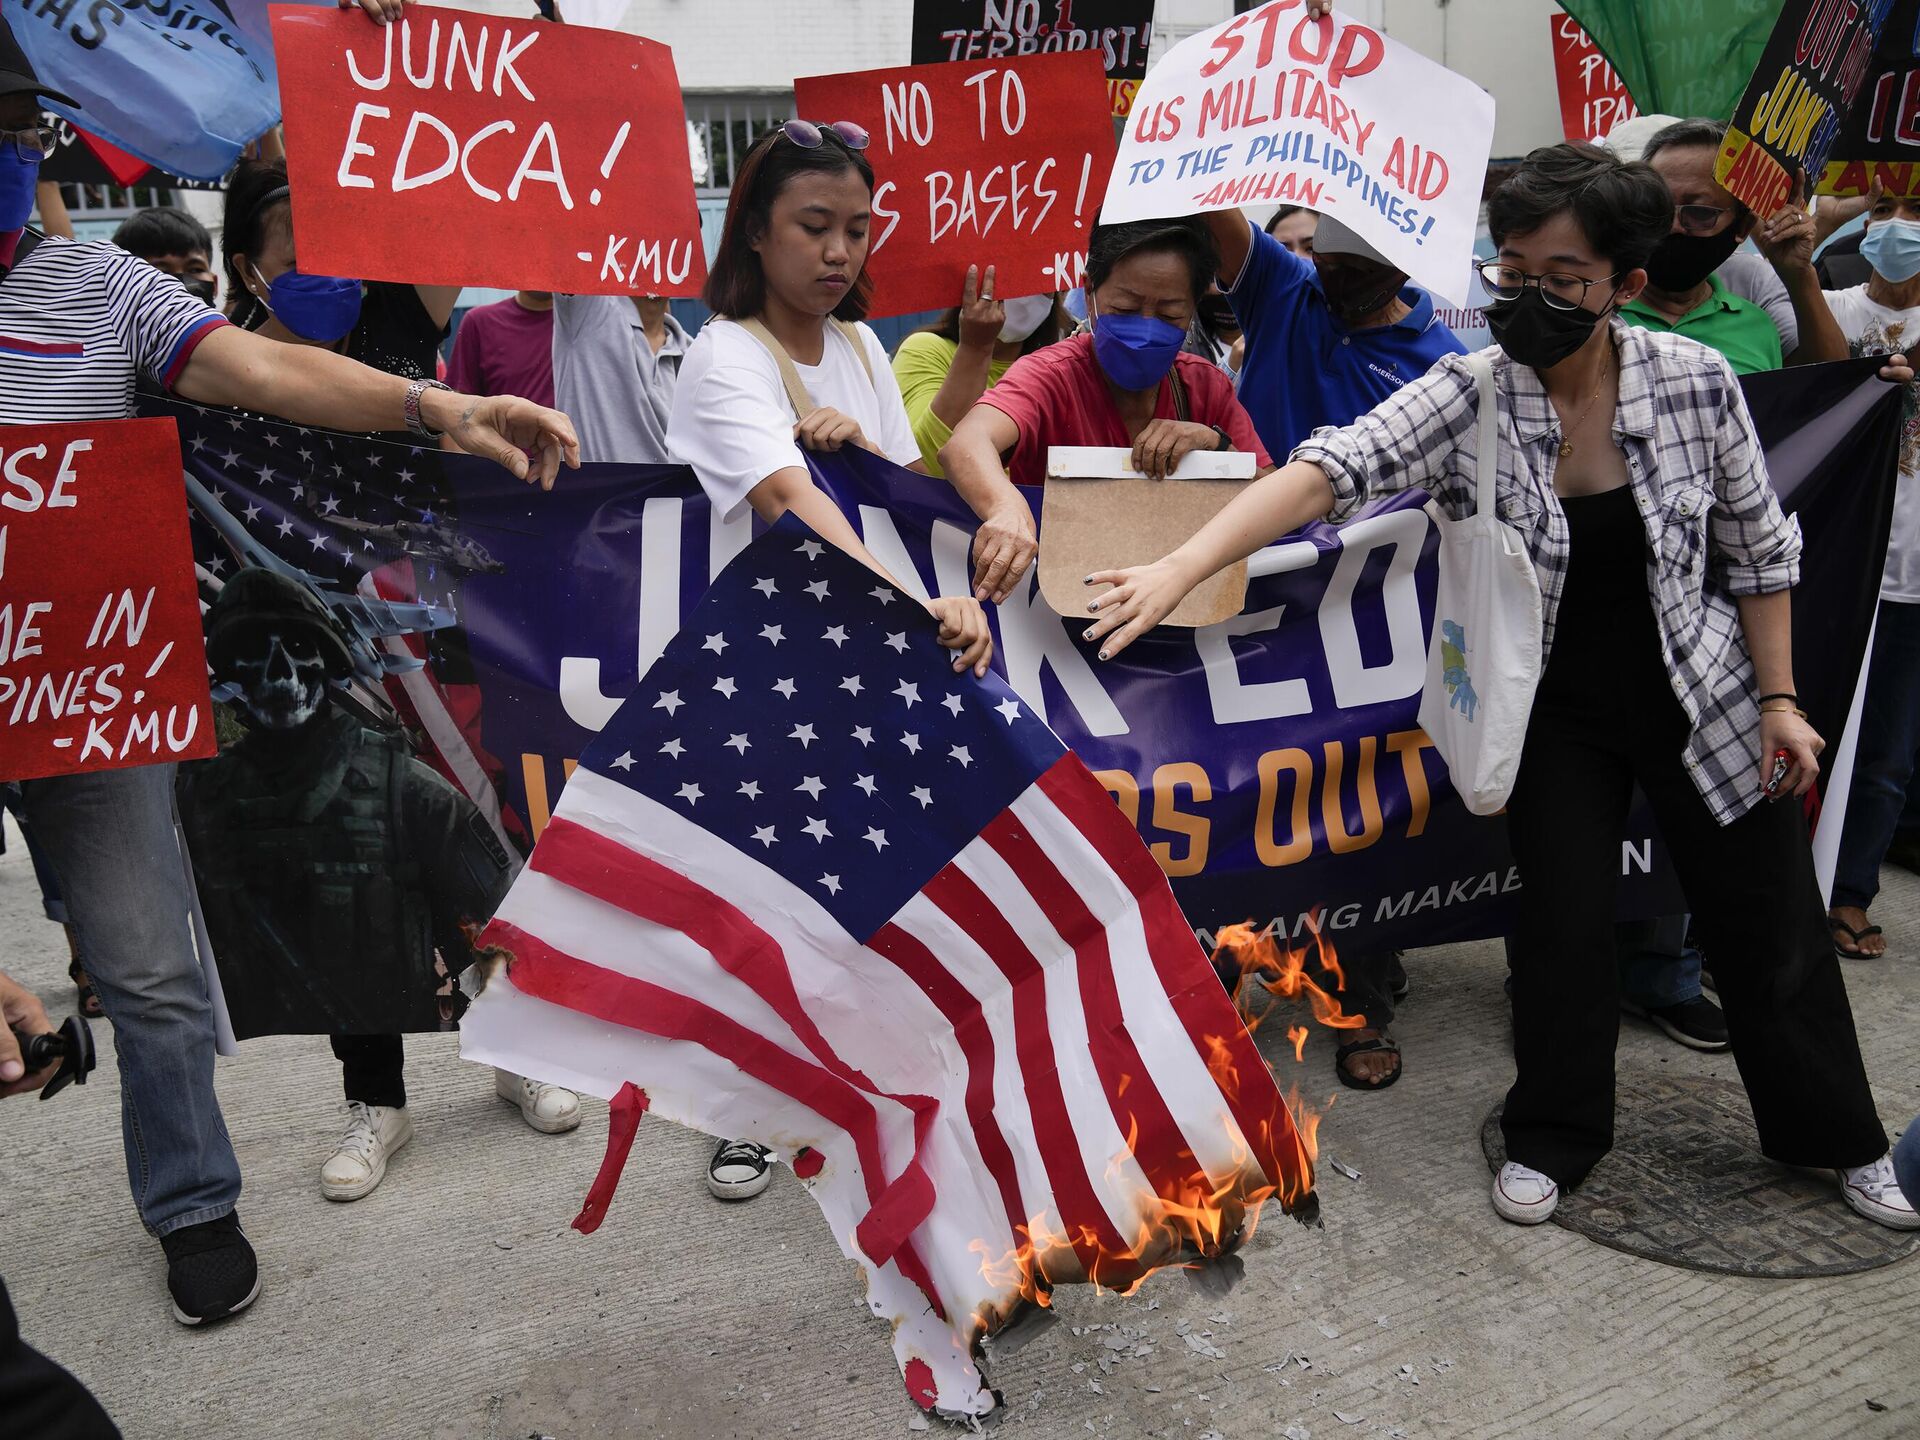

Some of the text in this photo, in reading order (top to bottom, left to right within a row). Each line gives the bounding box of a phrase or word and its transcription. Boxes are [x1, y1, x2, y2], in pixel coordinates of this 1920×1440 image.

[346, 19, 540, 101] JUNK
[1200, 0, 1384, 88] STOP
[882, 69, 1026, 155] NO TO
[1135, 69, 1449, 201] US MILITARY AID
[1750, 65, 1828, 161] JUNK
[337, 102, 631, 210] EDCA!
[1129, 130, 1436, 246] TO THE PHILIPPINES!
[1192, 172, 1336, 207] -AMIHAN-
[871, 153, 1092, 255] S BASES!
[577, 234, 692, 285] -KMU
[1368, 362, 1407, 388] EMERSON
[0, 439, 94, 512] SE
[86, 586, 156, 649] IN
[53, 704, 198, 763] -KMU
[1254, 728, 1436, 867] OUT
